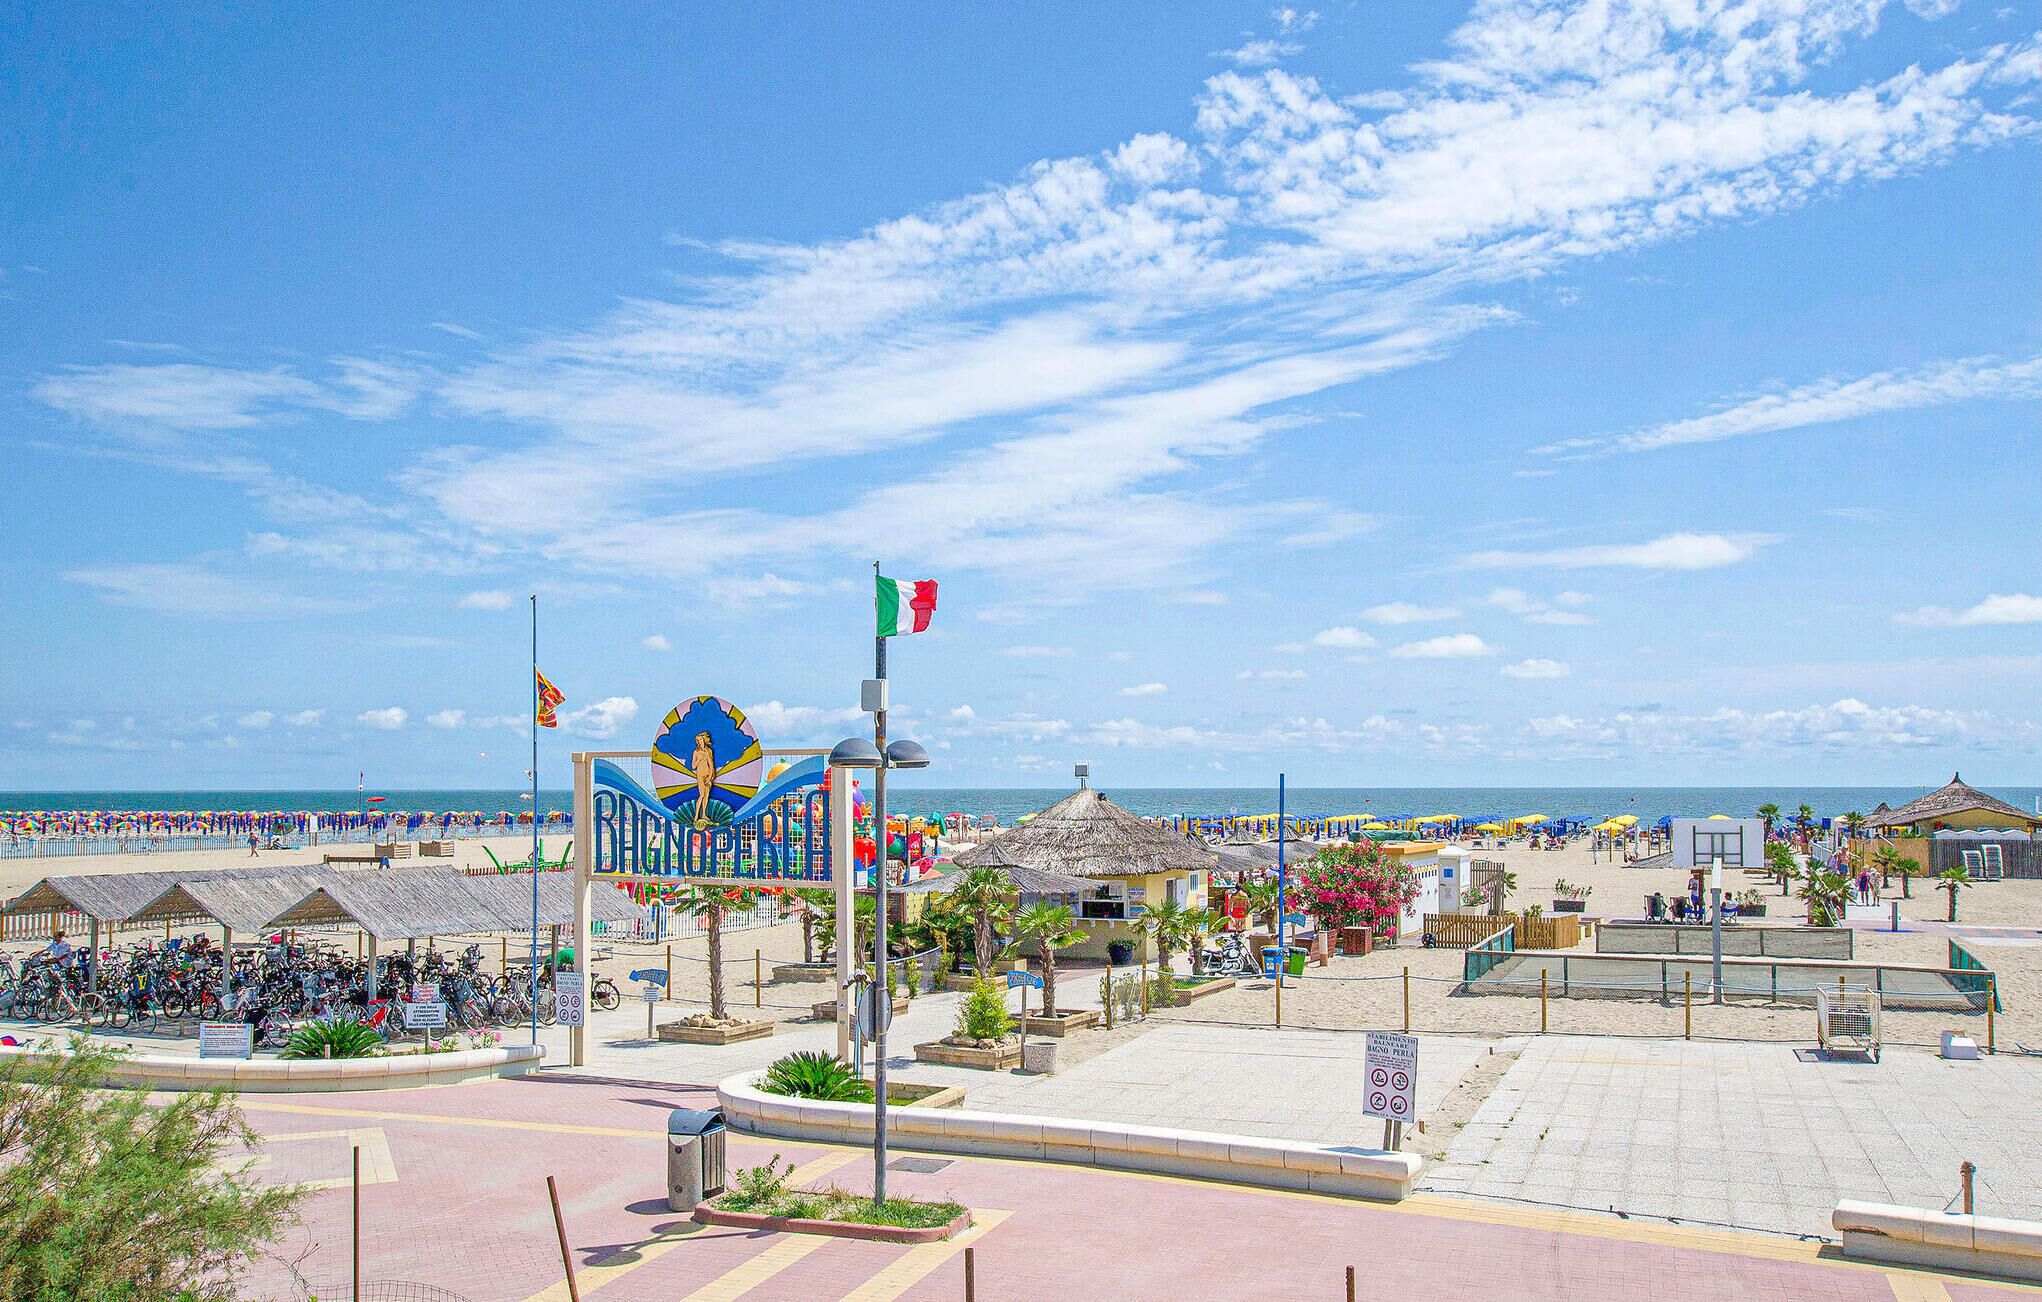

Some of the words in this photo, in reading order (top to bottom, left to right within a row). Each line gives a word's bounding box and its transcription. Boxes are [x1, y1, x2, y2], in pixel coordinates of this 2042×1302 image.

[1367, 1033, 1416, 1044] STABILIMENTO
[1373, 1040, 1408, 1049] BALNEARE
[1367, 1045, 1389, 1054] BAGNO
[1392, 1048, 1415, 1058] PERLA
